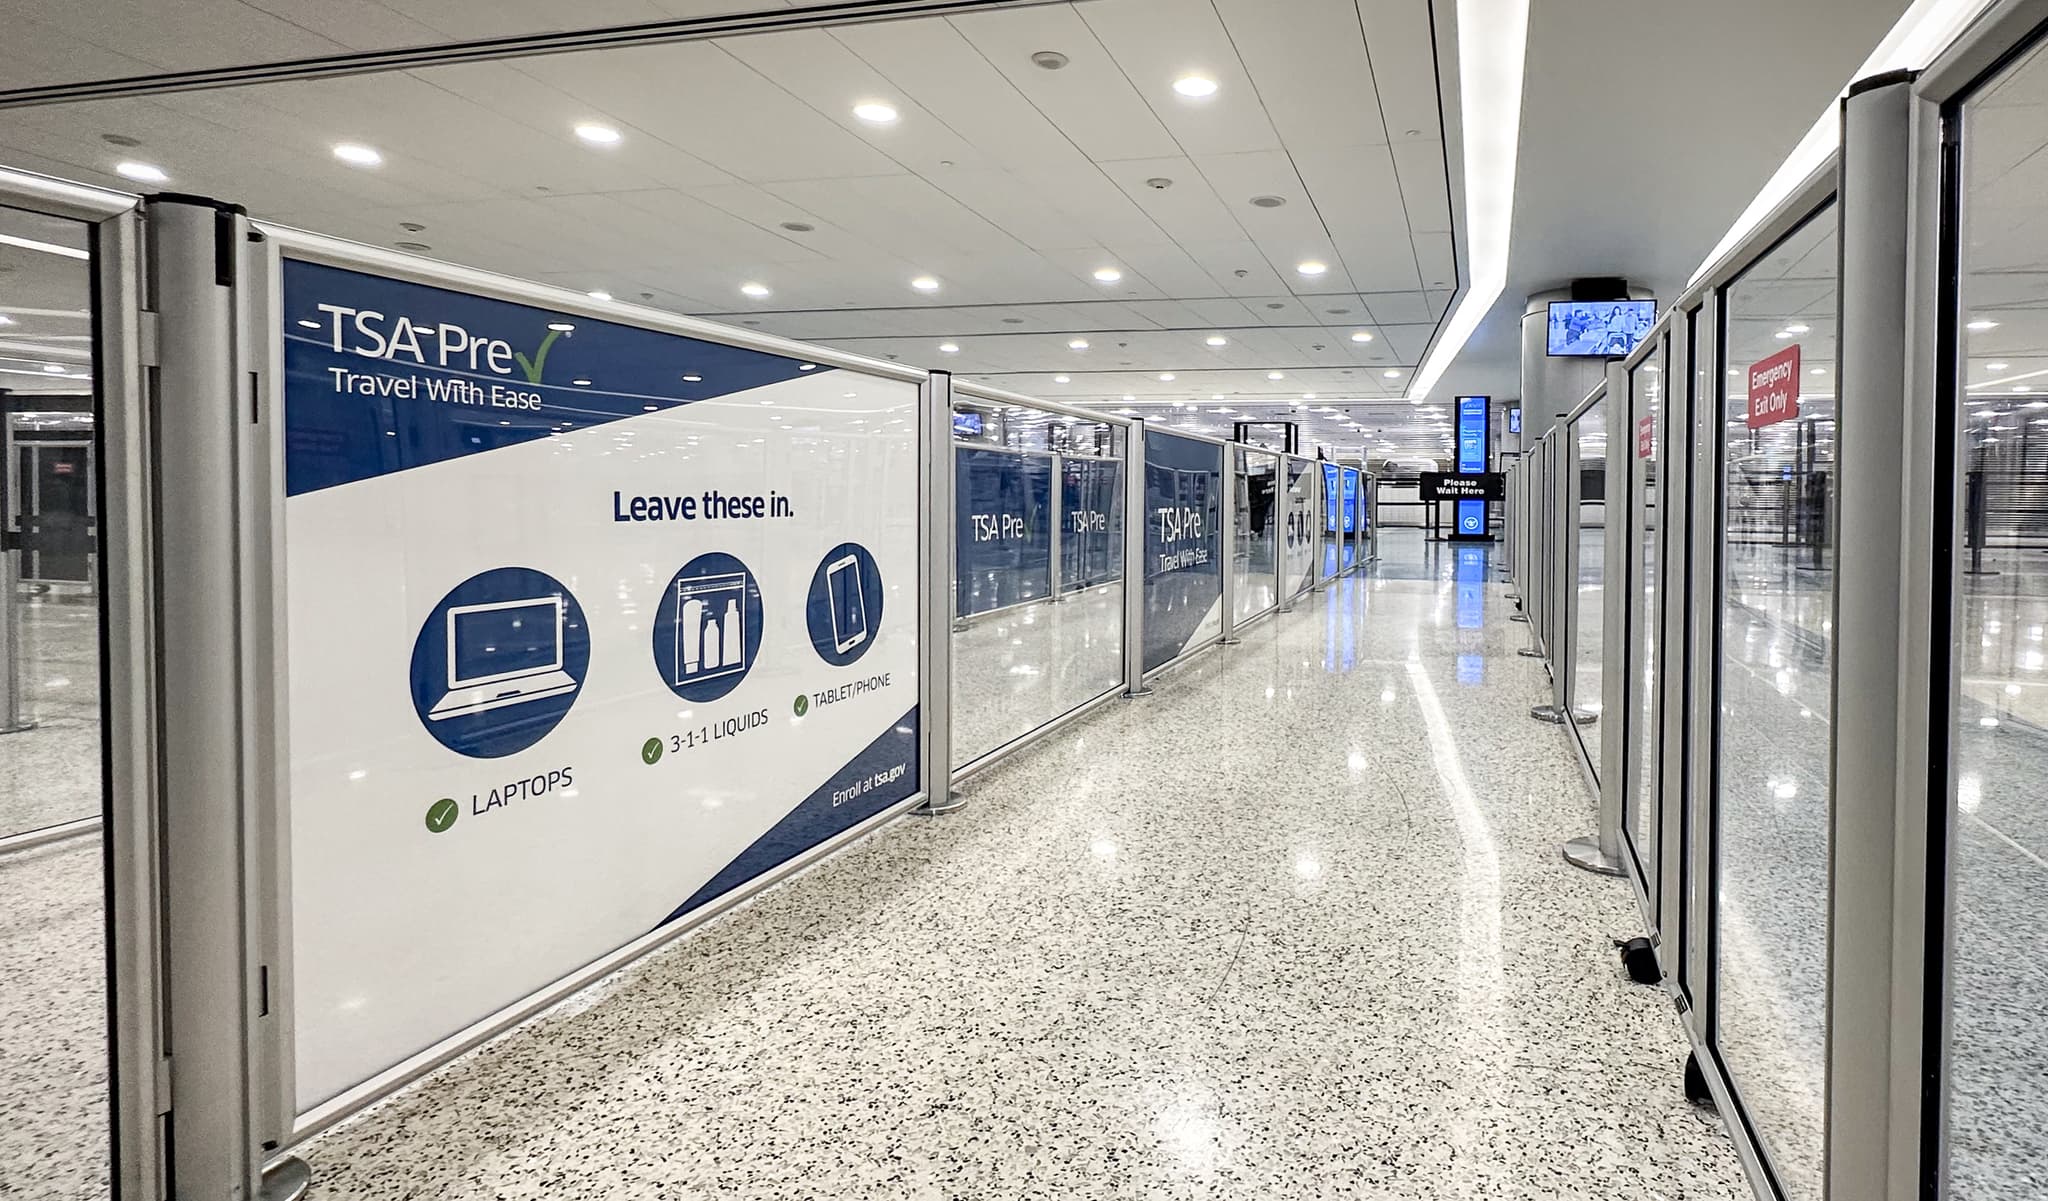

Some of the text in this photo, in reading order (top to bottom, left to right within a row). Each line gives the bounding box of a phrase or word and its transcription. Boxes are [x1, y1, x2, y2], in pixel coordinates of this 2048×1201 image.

[318, 303, 512, 374] TSA Pre
[328, 367, 542, 410] Travel With Ease
[1752, 359, 1793, 390] Emergency
[1755, 388, 1788, 417] Exit Only
[1436, 486, 1485, 495] Wait Here
[1443, 478, 1478, 487] Please
[613, 490, 794, 522] Leave these in.
[1071, 510, 1105, 533] TSA Pre
[971, 513, 1024, 542] TSA Pre
[1158, 507, 1201, 544] TSA Pre
[1159, 547, 1208, 573] Travel With Ease
[813, 672, 891, 709] TABLET/PHONE
[670, 708, 769, 753] 3-1-1 LIQUIDS
[472, 766, 573, 816] LAPTOPS
[832, 762, 906, 808] Enroll at tsa.gov
